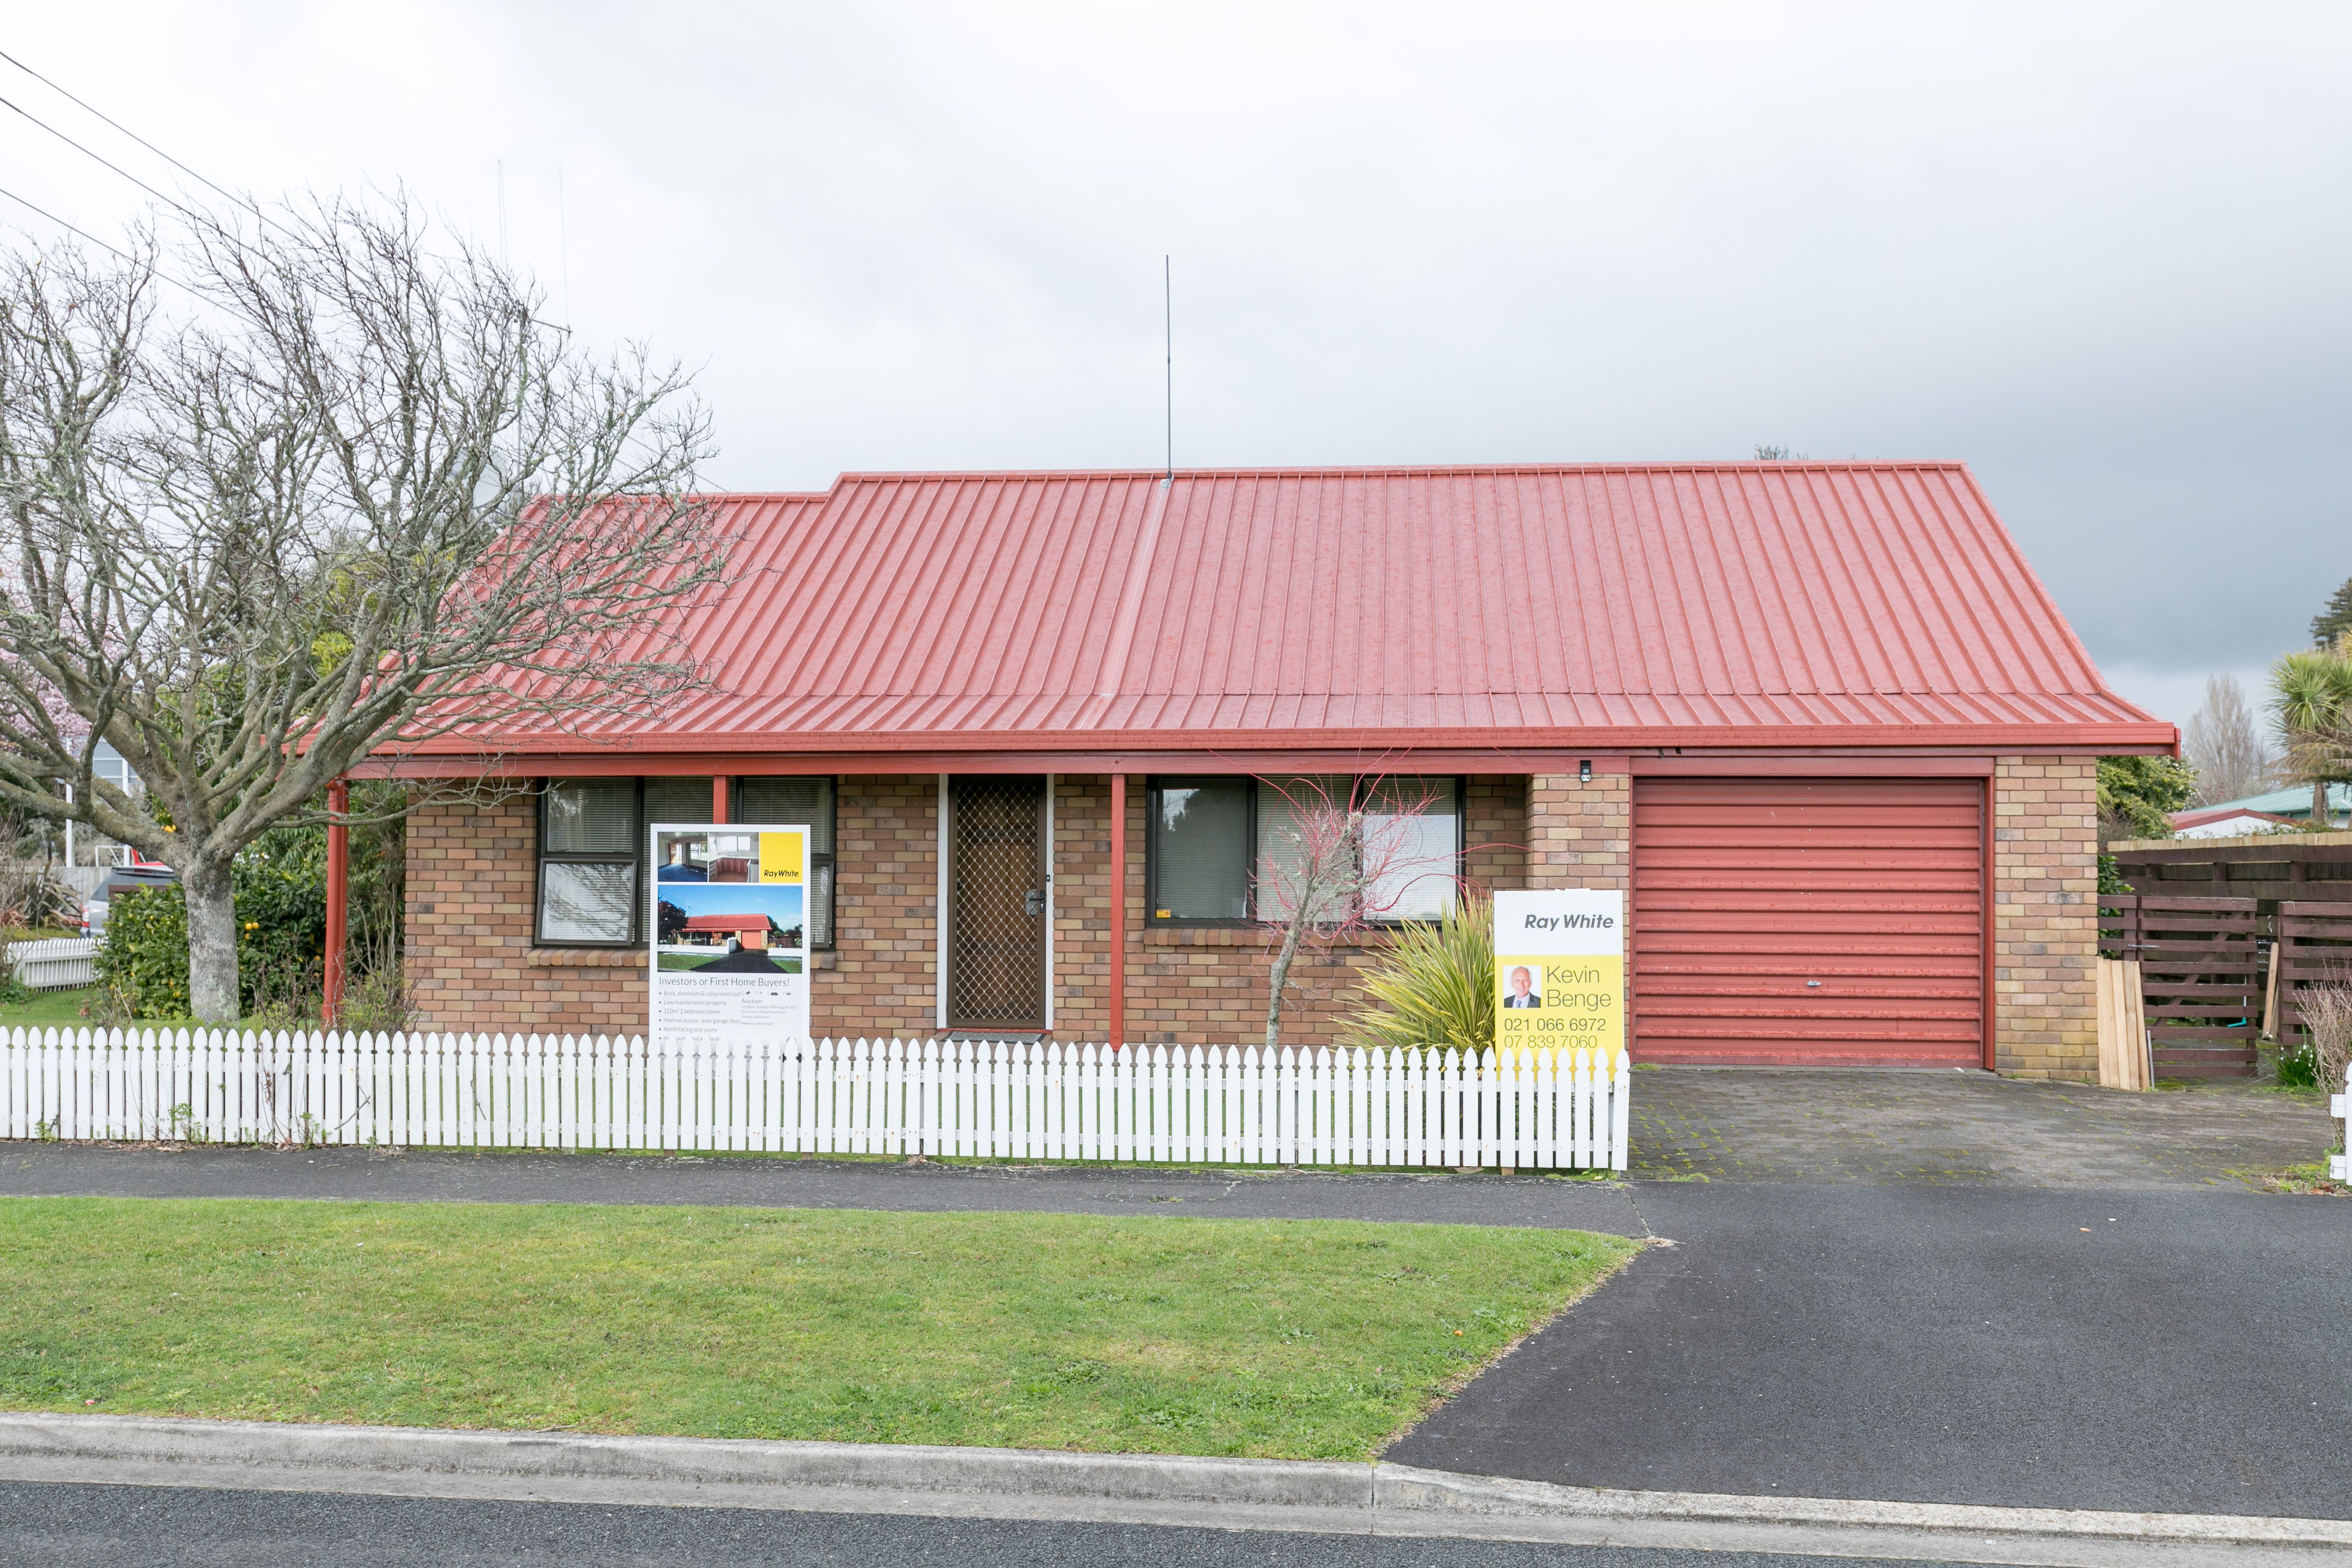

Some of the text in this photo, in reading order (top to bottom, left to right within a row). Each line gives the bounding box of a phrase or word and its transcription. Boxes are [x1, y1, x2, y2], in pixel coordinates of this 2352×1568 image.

[1525, 914, 1614, 931] Ray White
[1547, 965, 1600, 983] Kevin
[659, 977, 697, 986] Investors
[710, 977, 729, 986] First
[731, 978, 756, 986] Home
[758, 978, 790, 988] Buyers!
[1547, 989, 1611, 1012] Benge
[1505, 1018, 1606, 1031] 021 066 6972
[1505, 1035, 1597, 1049] 07 839 7060
